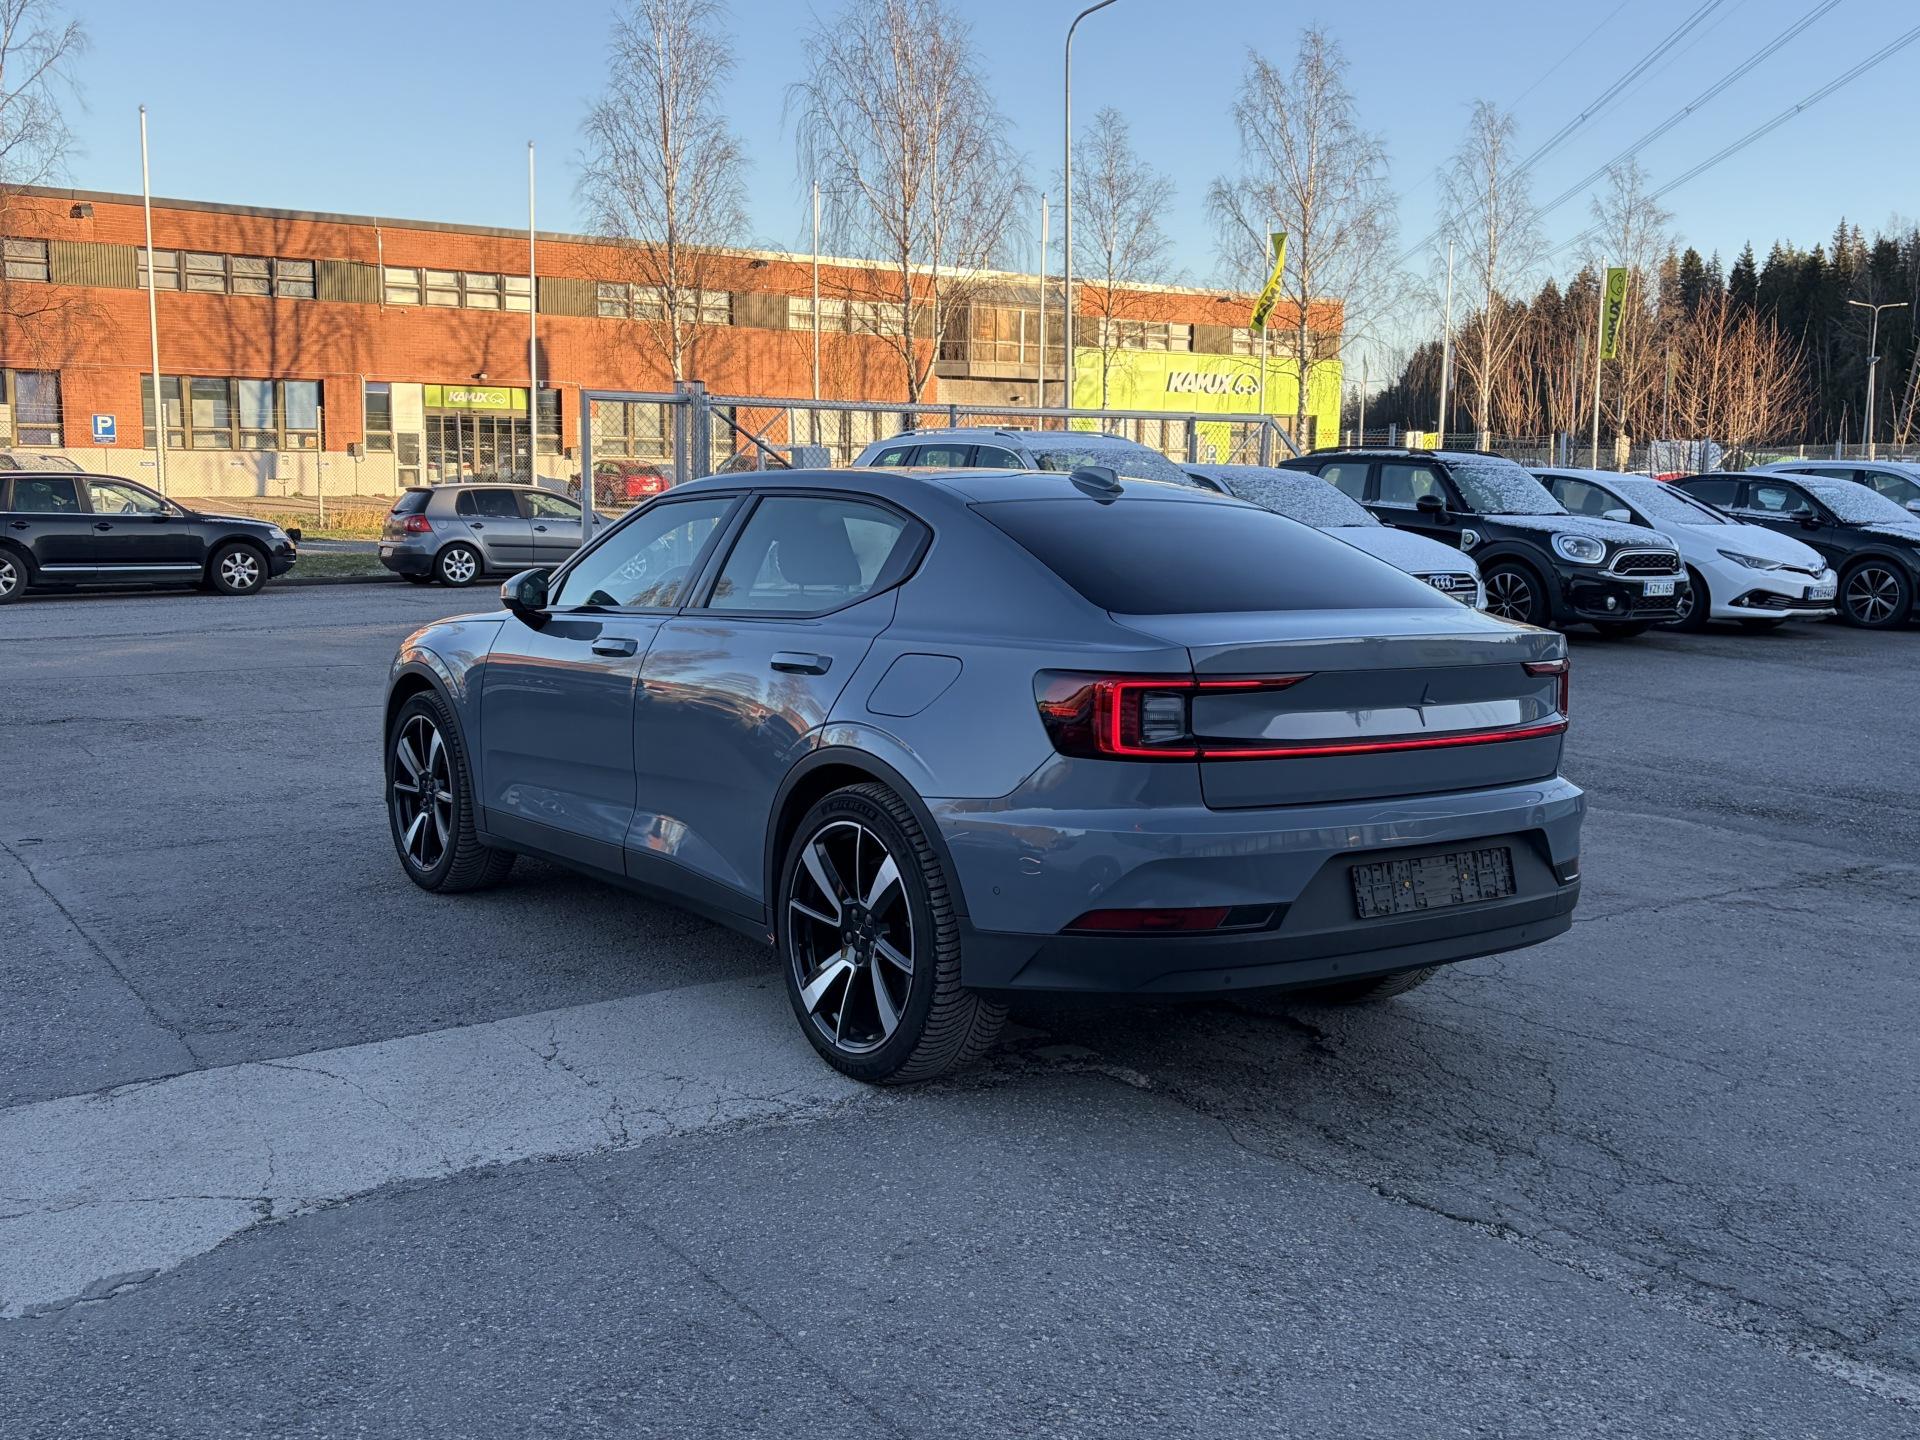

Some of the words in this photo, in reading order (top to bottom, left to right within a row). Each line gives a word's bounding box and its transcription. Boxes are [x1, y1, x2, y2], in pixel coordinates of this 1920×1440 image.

[1606, 298, 1621, 353] KAMUX
[1166, 372, 1232, 394] KAMUX
[448, 391, 489, 403] KAMUX
[97, 416, 112, 435] P
